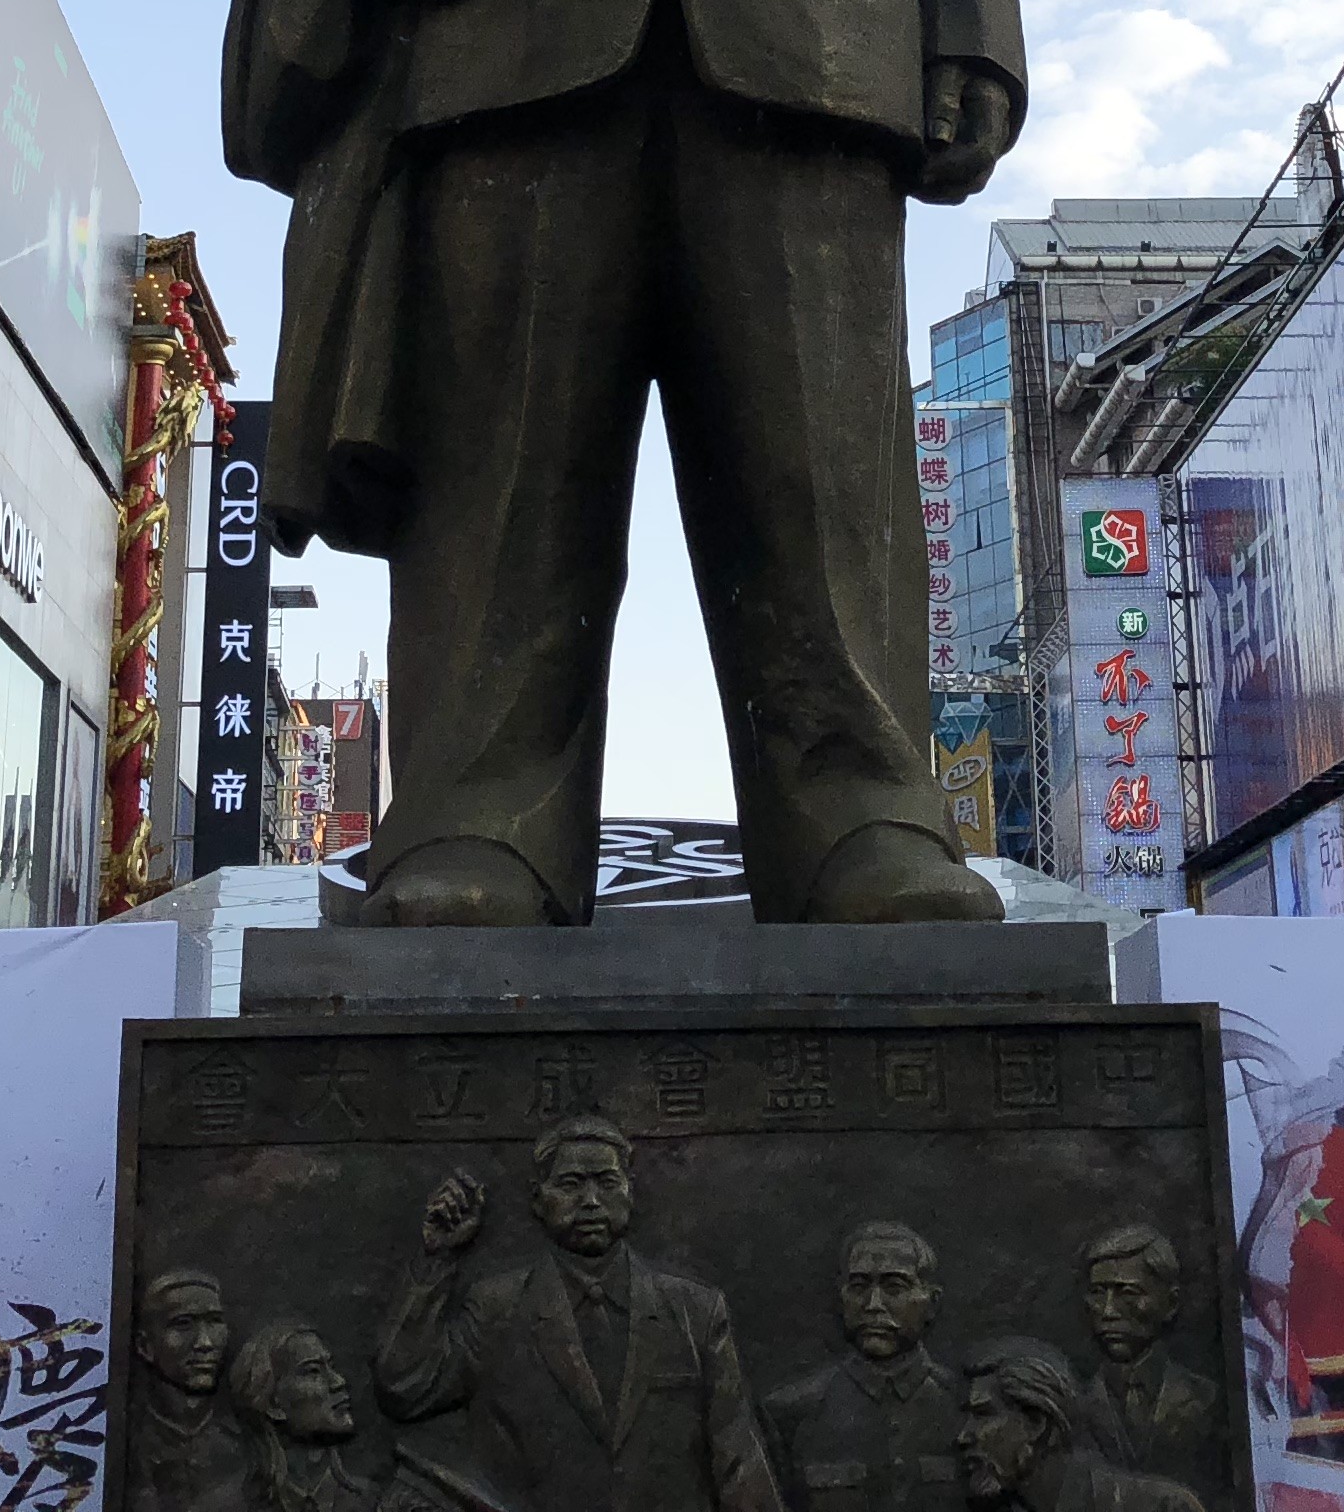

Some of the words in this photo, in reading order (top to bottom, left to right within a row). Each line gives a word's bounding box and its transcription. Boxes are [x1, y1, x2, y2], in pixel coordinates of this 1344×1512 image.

[217, 460, 259, 568] CRD
[918, 416, 956, 669] 蝴蝶树婚纱艺术
[1121, 611, 1144, 633] 新
[211, 618, 254, 815] 克徕帝
[338, 704, 360, 736] 7
[1105, 845, 1164, 876] 火锅
